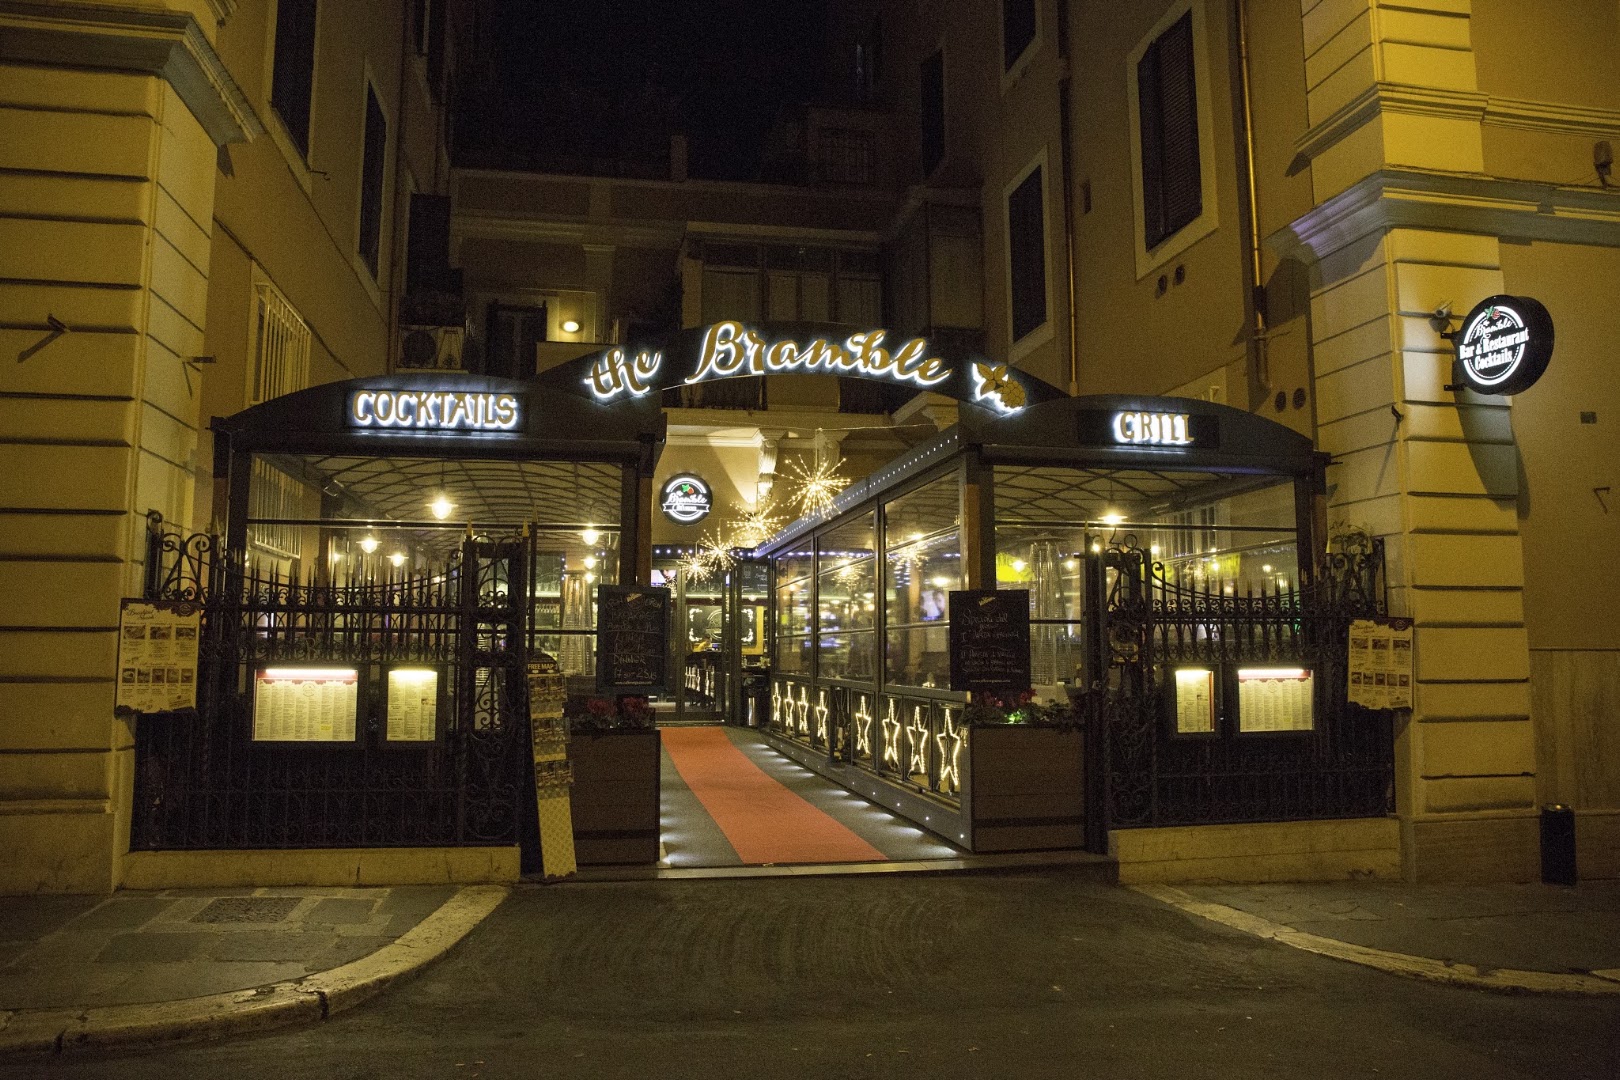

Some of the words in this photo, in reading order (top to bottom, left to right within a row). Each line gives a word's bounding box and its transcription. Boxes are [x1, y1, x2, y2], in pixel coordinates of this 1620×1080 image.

[583, 349, 661, 398] the
[684, 320, 953, 385] Bramble
[1459, 345, 1475, 359] Bar
[1483, 327, 1529, 352] Restaurant
[1474, 348, 1513, 370] Cocktails
[353, 390, 518, 427] COCKTAILS
[1115, 410, 1195, 443] GRILL
